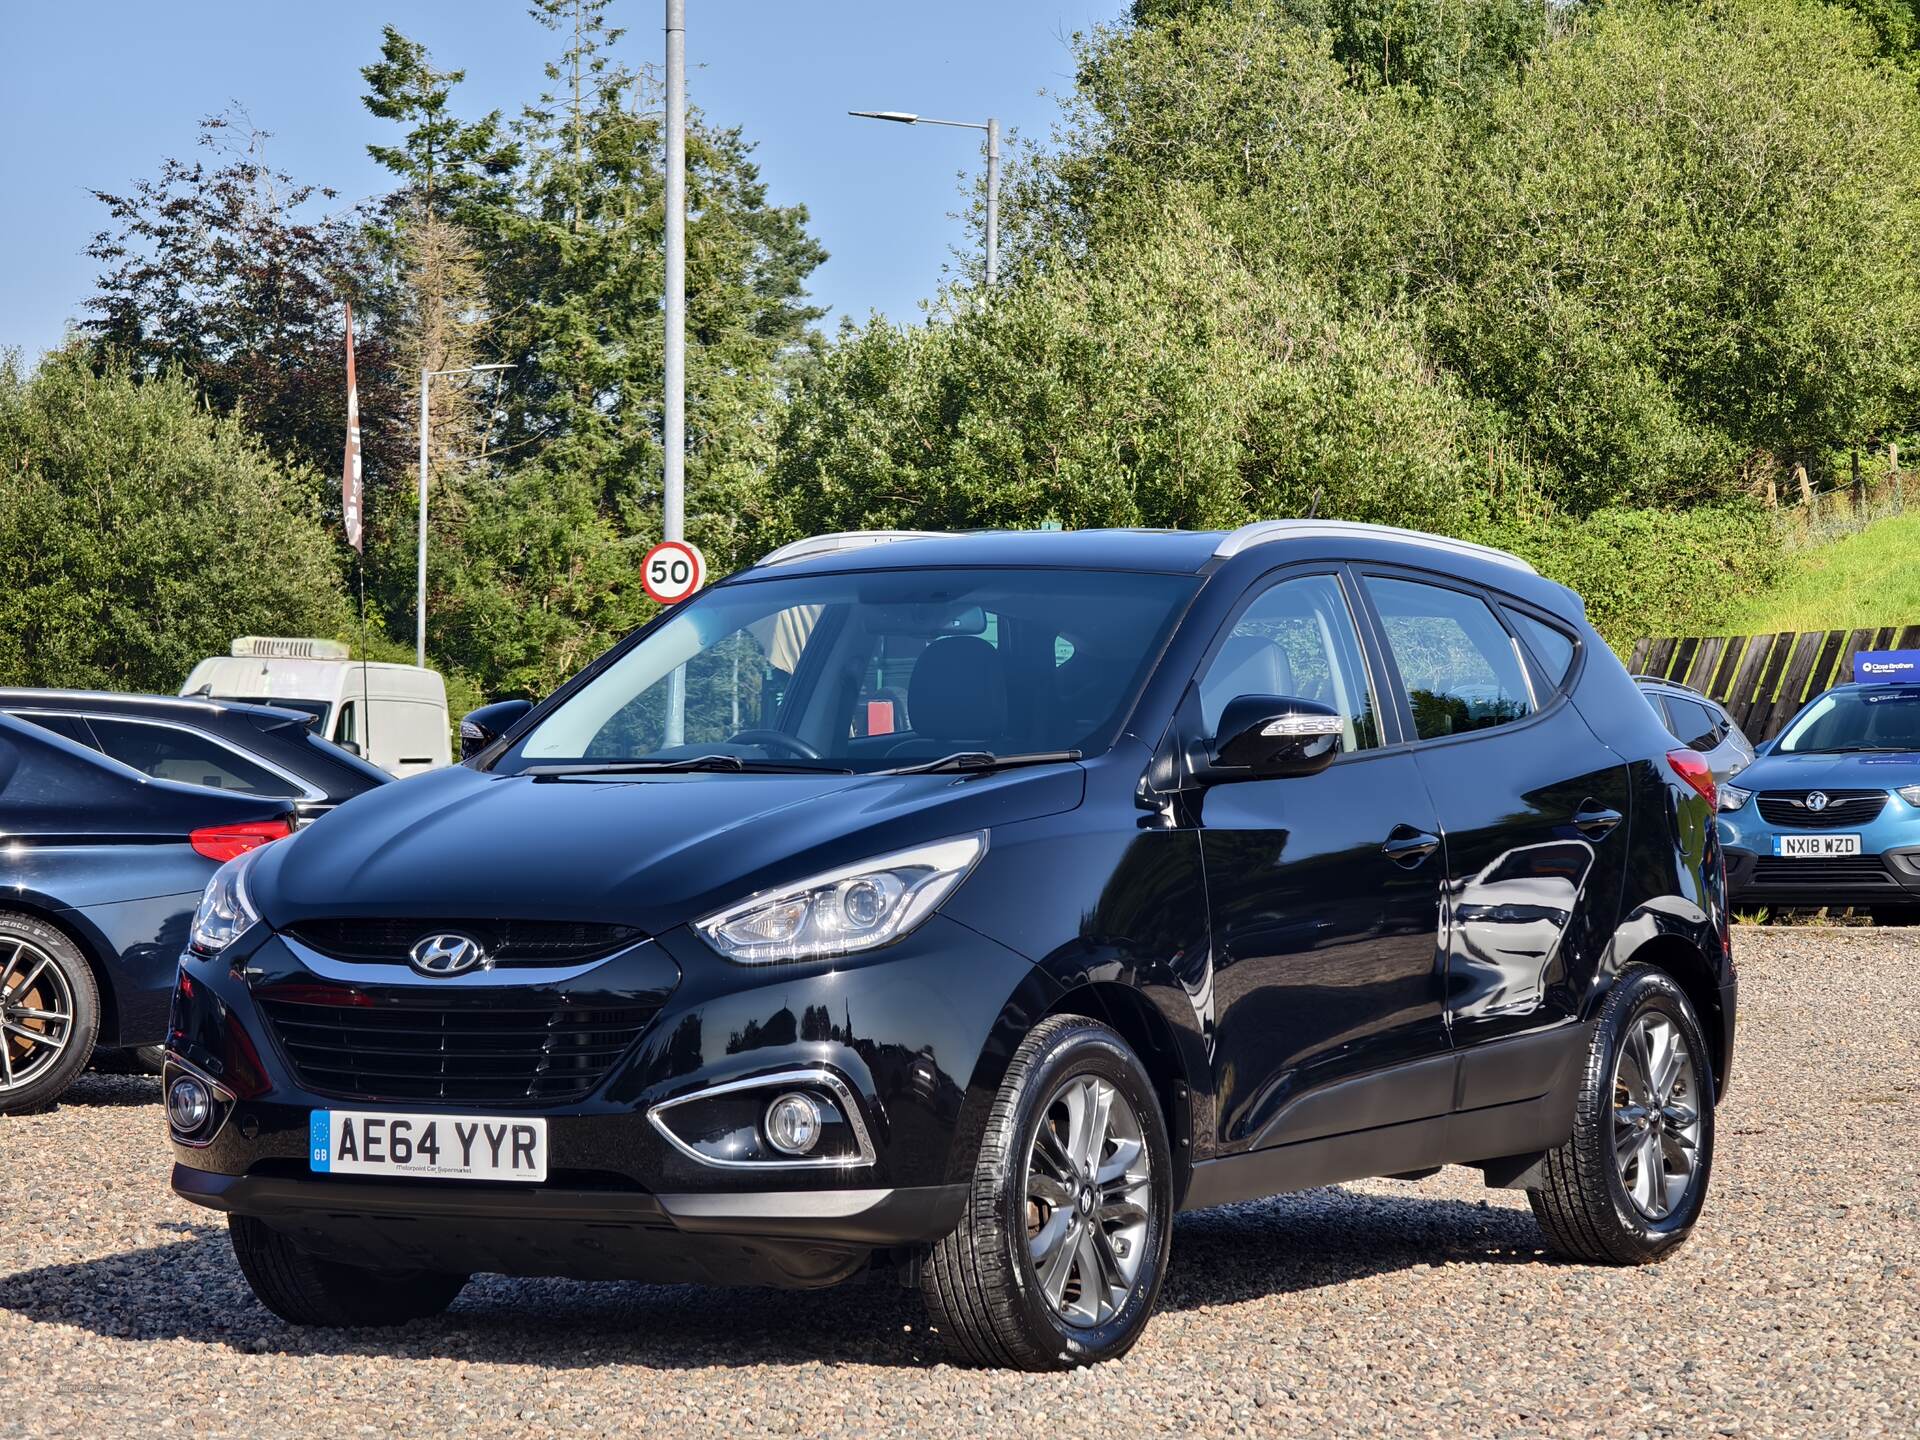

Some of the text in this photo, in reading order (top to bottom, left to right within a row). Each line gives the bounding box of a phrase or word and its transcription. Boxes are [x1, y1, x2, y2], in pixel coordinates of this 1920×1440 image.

[651, 560, 690, 584] 50
[1786, 838, 1854, 854] NX18 WZD
[337, 1117, 536, 1170] AE64 YYR
[314, 1148, 328, 1161] GB
